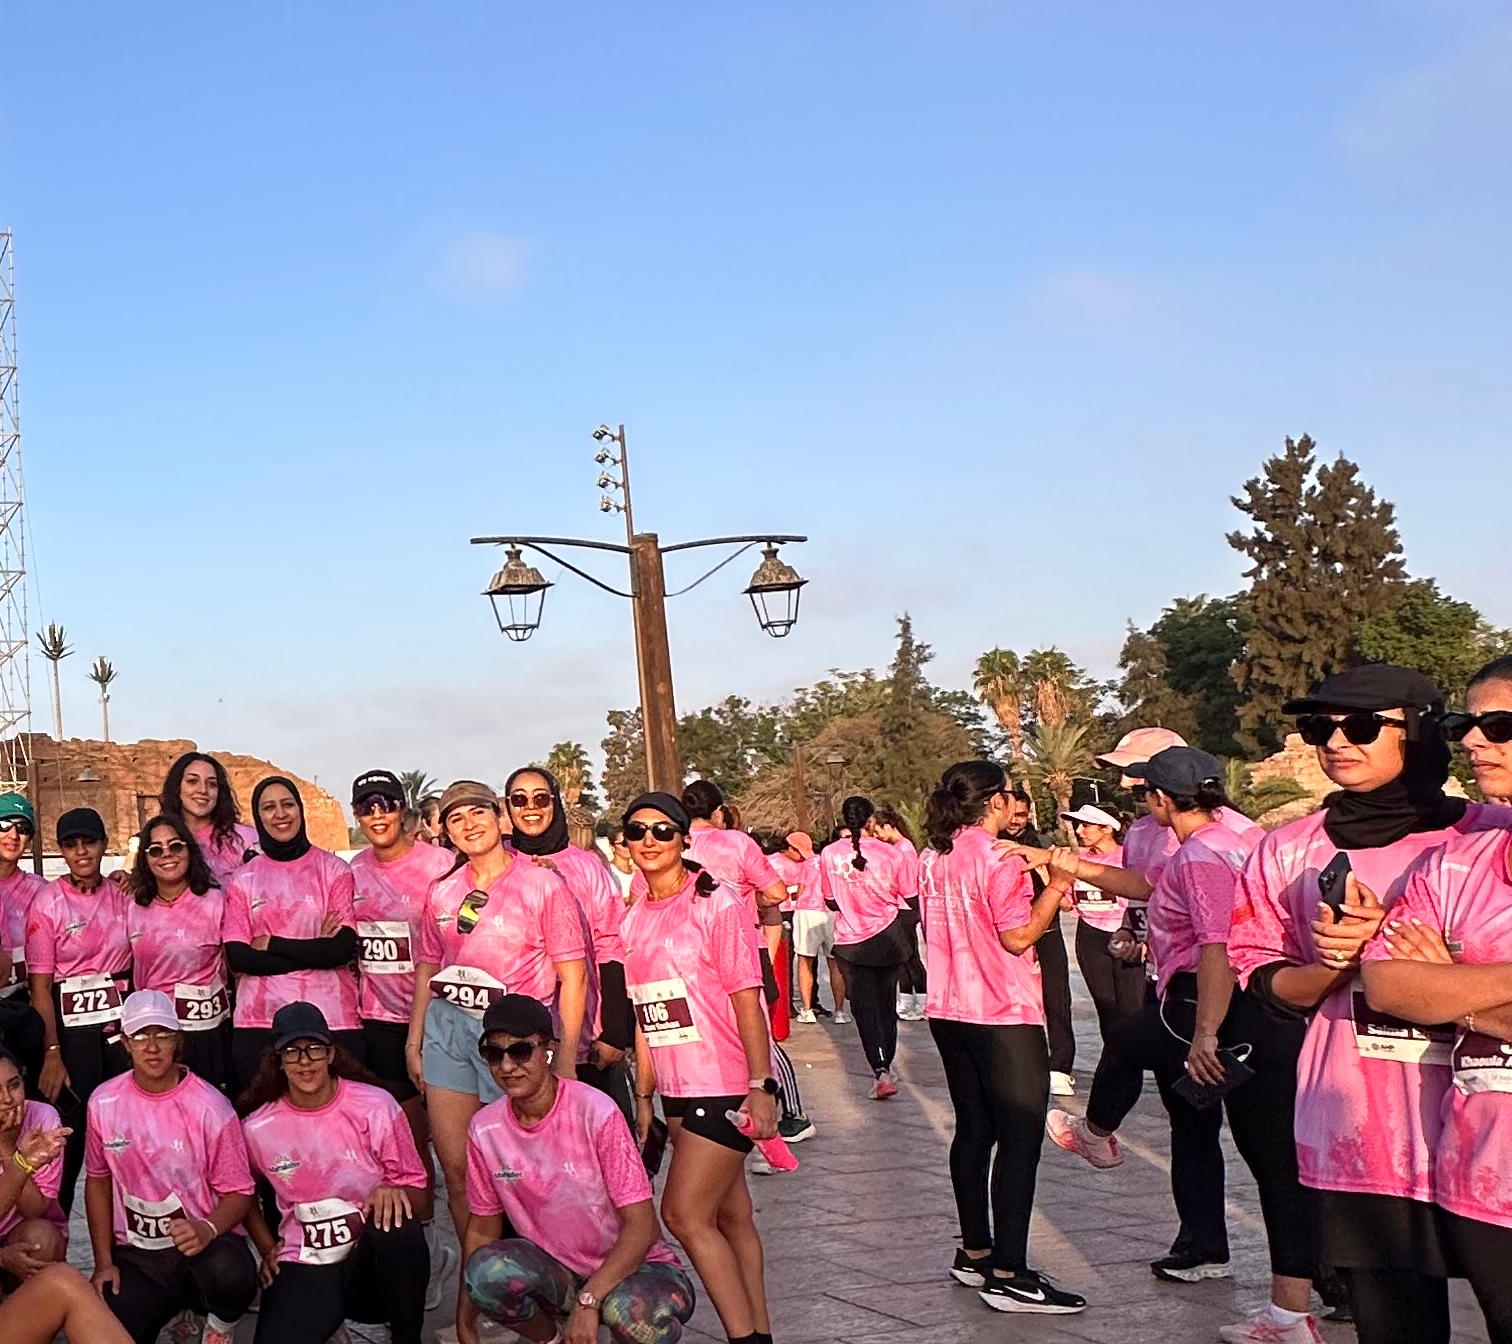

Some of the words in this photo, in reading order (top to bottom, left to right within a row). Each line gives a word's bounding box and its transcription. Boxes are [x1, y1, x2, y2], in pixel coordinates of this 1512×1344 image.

[362, 939, 398, 960] 290
[72, 989, 110, 1013] 272
[186, 995, 222, 1019] 293
[443, 984, 490, 1009] 294
[642, 1002, 669, 1023] 106
[305, 1218, 352, 1248] 275
